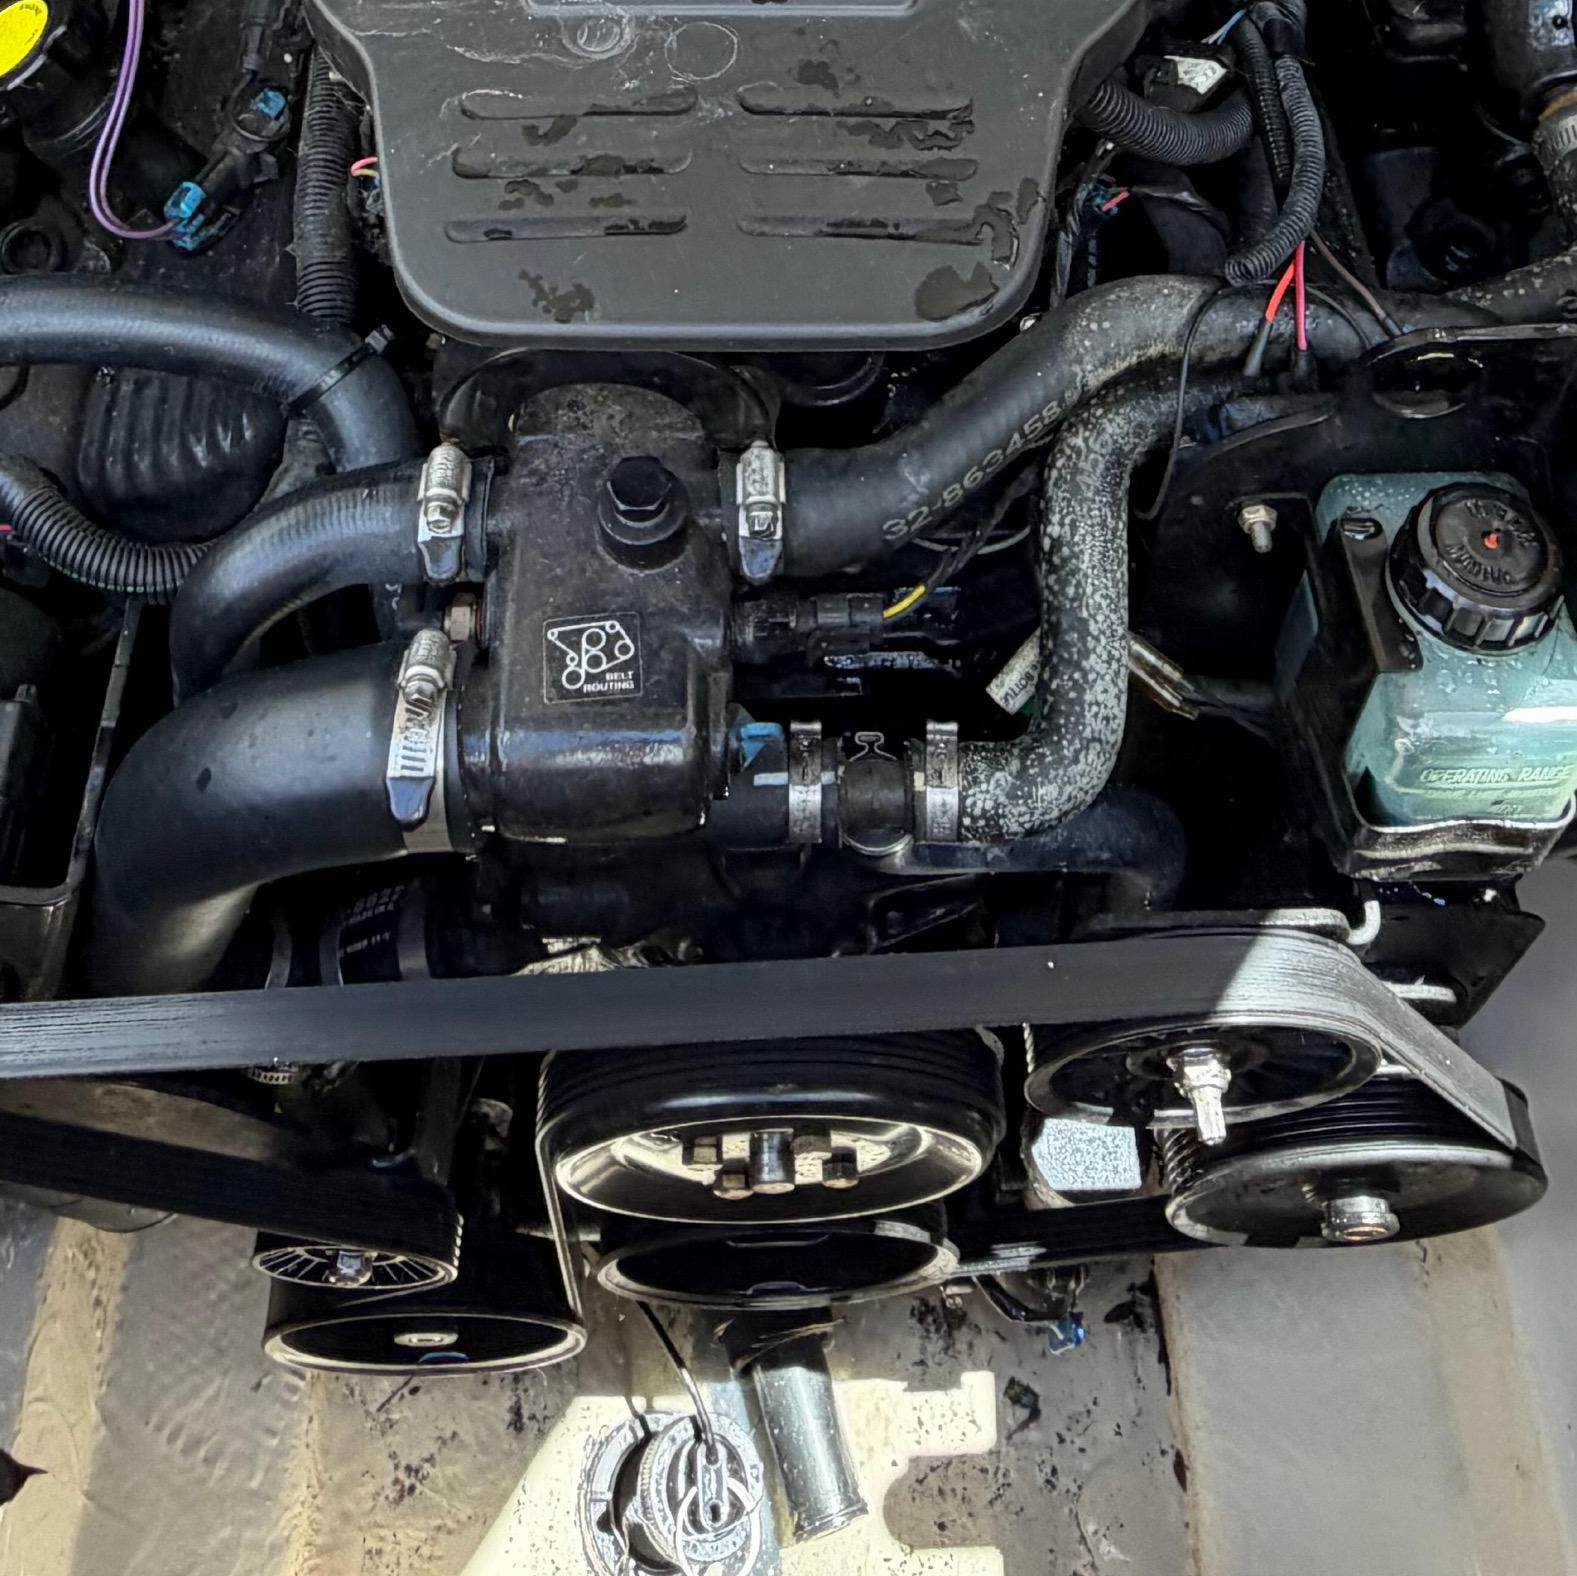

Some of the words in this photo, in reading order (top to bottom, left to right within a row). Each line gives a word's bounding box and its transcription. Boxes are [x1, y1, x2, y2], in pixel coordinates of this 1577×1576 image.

[605, 670, 634, 681] BELT
[583, 681, 635, 693] ROUTING
[1420, 767, 1513, 785] OPERATING
[1517, 764, 1575, 783] RANGE
